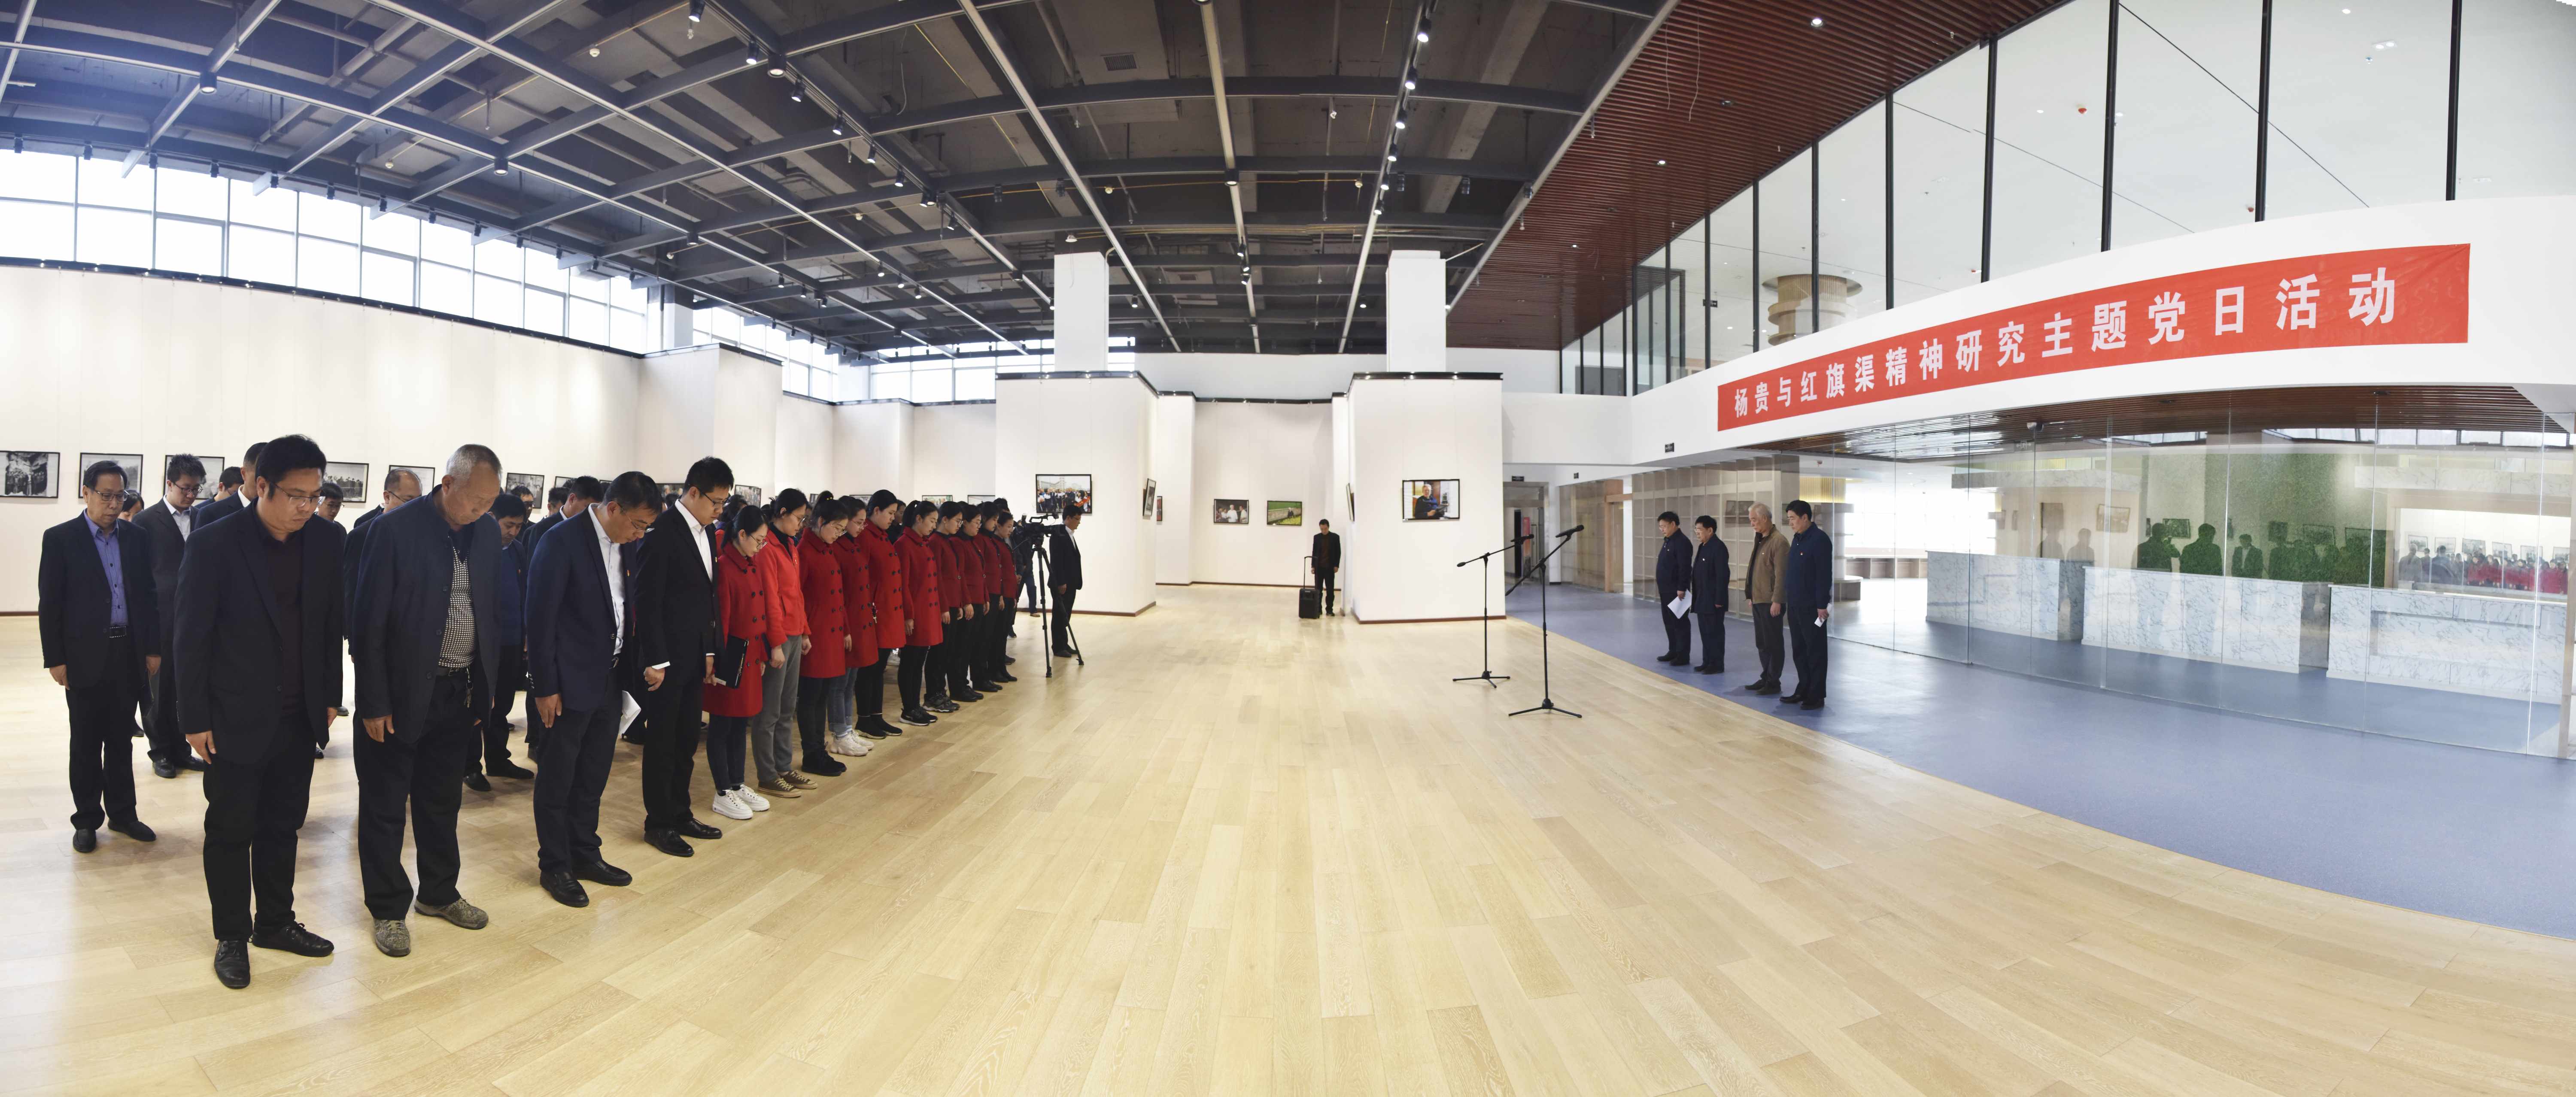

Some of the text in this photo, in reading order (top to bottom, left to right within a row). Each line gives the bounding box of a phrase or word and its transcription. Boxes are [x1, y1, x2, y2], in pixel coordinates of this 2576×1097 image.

[1735, 267, 2395, 418] 杨贵与红旗渠精神研究主题党日活动
